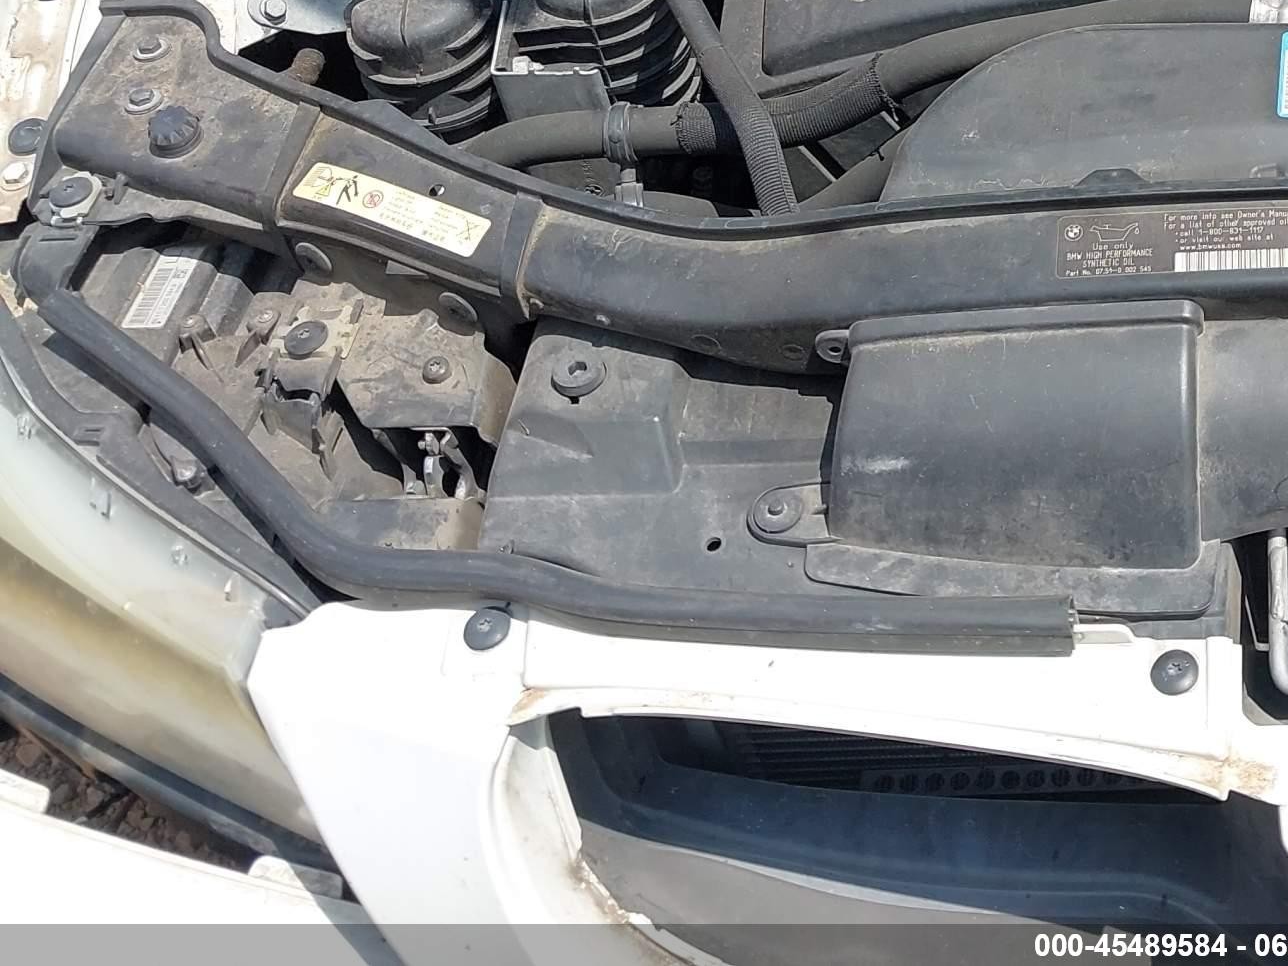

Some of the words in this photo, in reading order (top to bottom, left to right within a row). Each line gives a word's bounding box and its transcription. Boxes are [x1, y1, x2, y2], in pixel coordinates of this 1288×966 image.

[1164, 213, 1176, 222] For
[1202, 211, 1217, 220] info
[1237, 209, 1266, 219] Owner's
[1189, 219, 1202, 229] list
[1206, 219, 1215, 228] of
[1219, 218, 1239, 228] other
[1243, 216, 1276, 227] approved
[1199, 225, 1264, 236] 1-800-831-1117
[1192, 235, 1209, 243] visit
[1266, 232, 1274, 241] at
[1092, 242, 1109, 251] Use
[1113, 241, 1134, 251] only
[1066, 252, 1083, 261] BMW
[1085, 250, 1103, 260] HIGH
[1105, 247, 1153, 259] PERFORMANCE
[1082, 259, 1120, 268] SYNTHETIC
[1123, 257, 1135, 266] OIL
